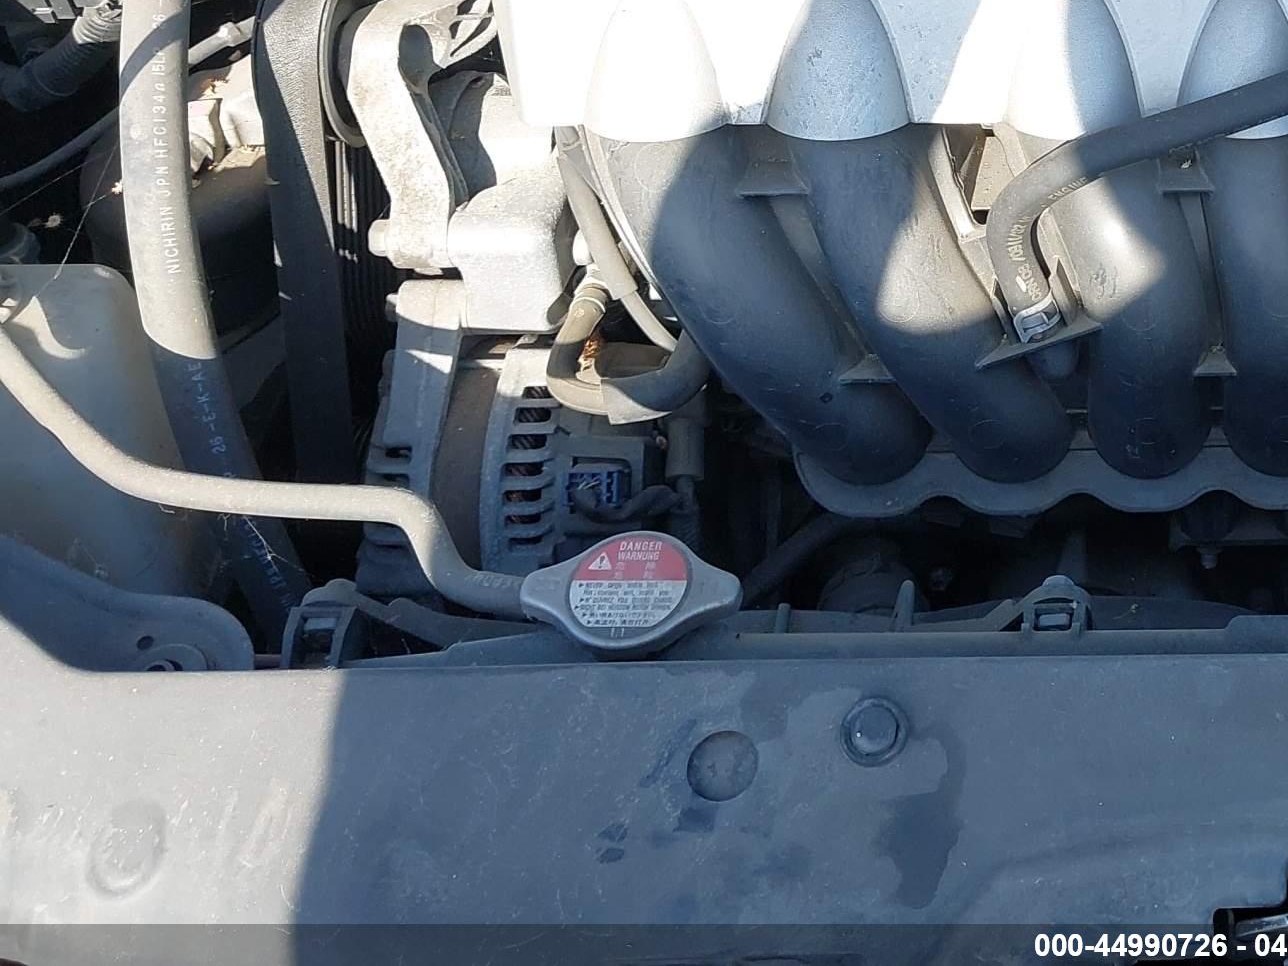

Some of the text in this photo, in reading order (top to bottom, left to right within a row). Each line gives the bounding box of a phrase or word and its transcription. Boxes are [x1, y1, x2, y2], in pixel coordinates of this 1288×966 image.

[155, 165, 172, 197] JPN
[159, 206, 182, 275] NICHIRIN
[617, 551, 660, 561] WARNUNG
[619, 541, 663, 551] DANGER
